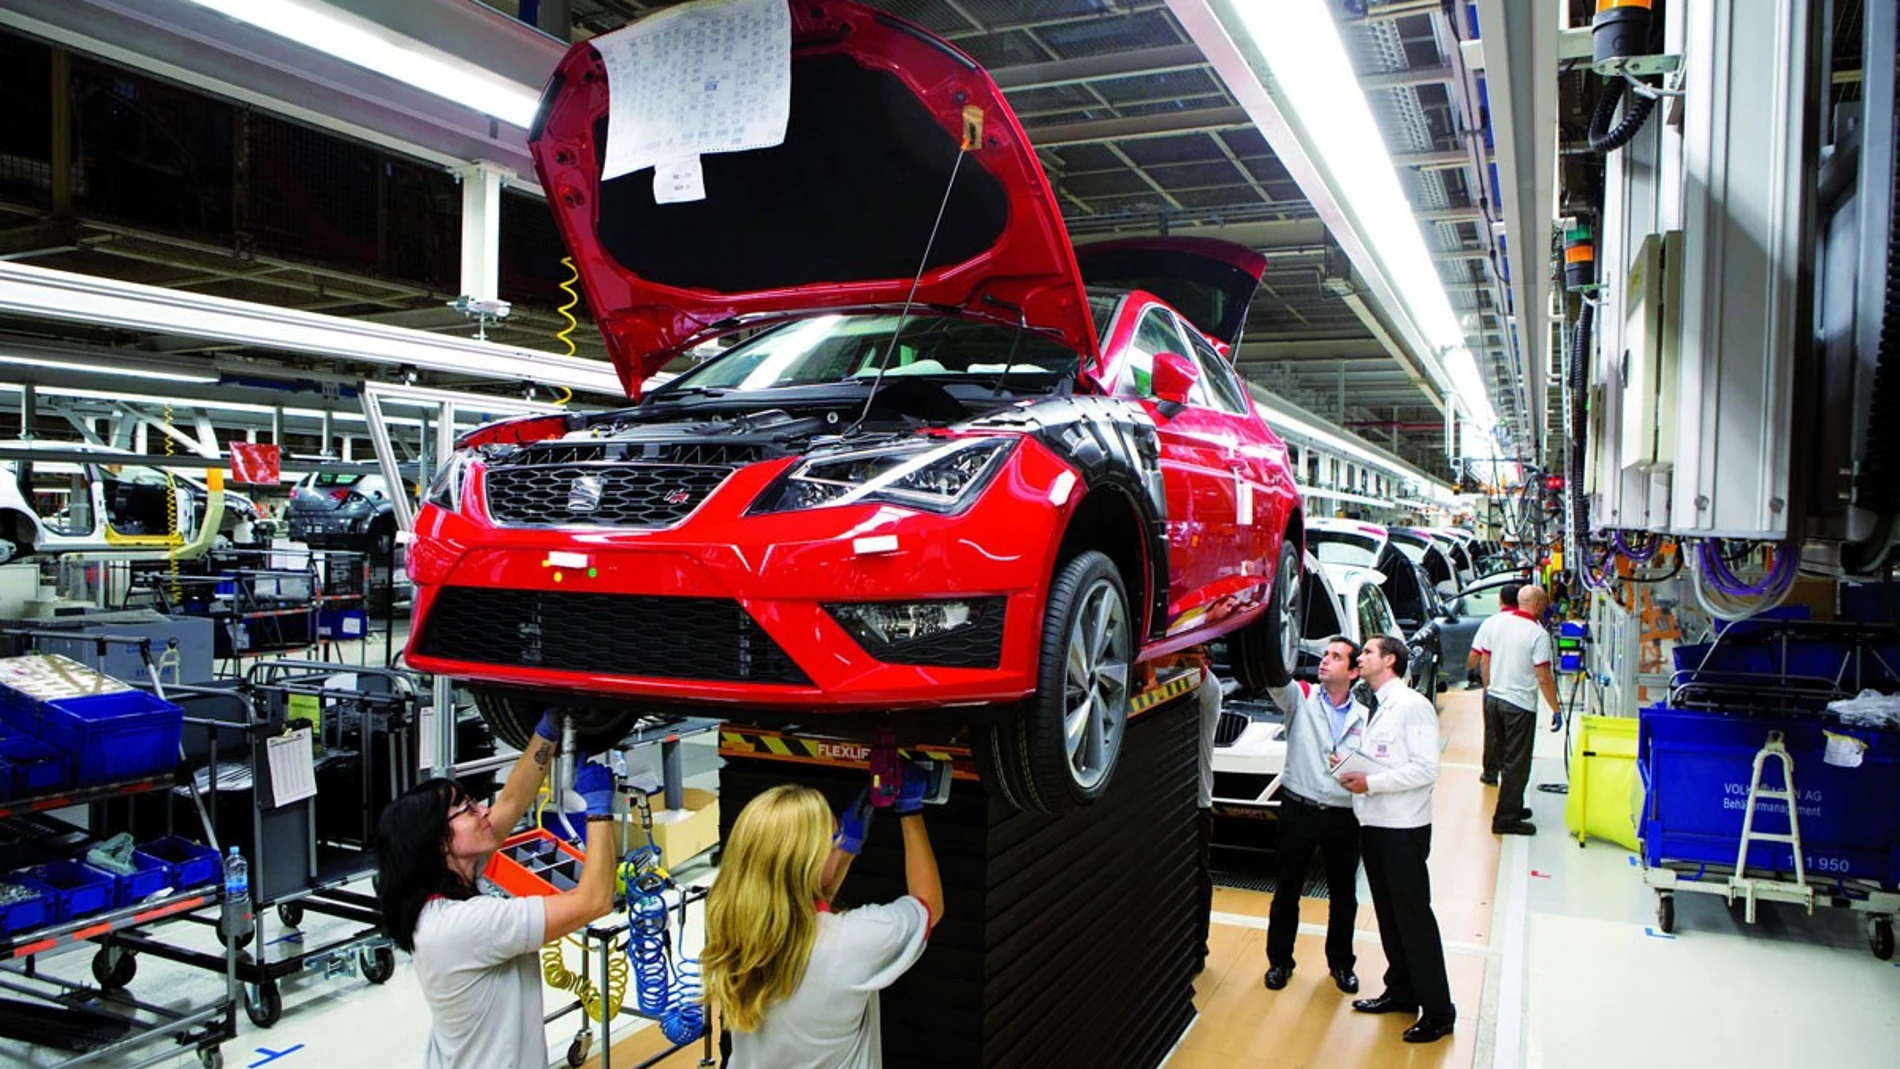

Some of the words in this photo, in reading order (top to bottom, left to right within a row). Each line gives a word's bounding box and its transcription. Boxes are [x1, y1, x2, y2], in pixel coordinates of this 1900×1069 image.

[818, 743, 871, 759] FLEXLIF
[1805, 788, 1821, 802] AG
[1818, 857, 1850, 872] 950
